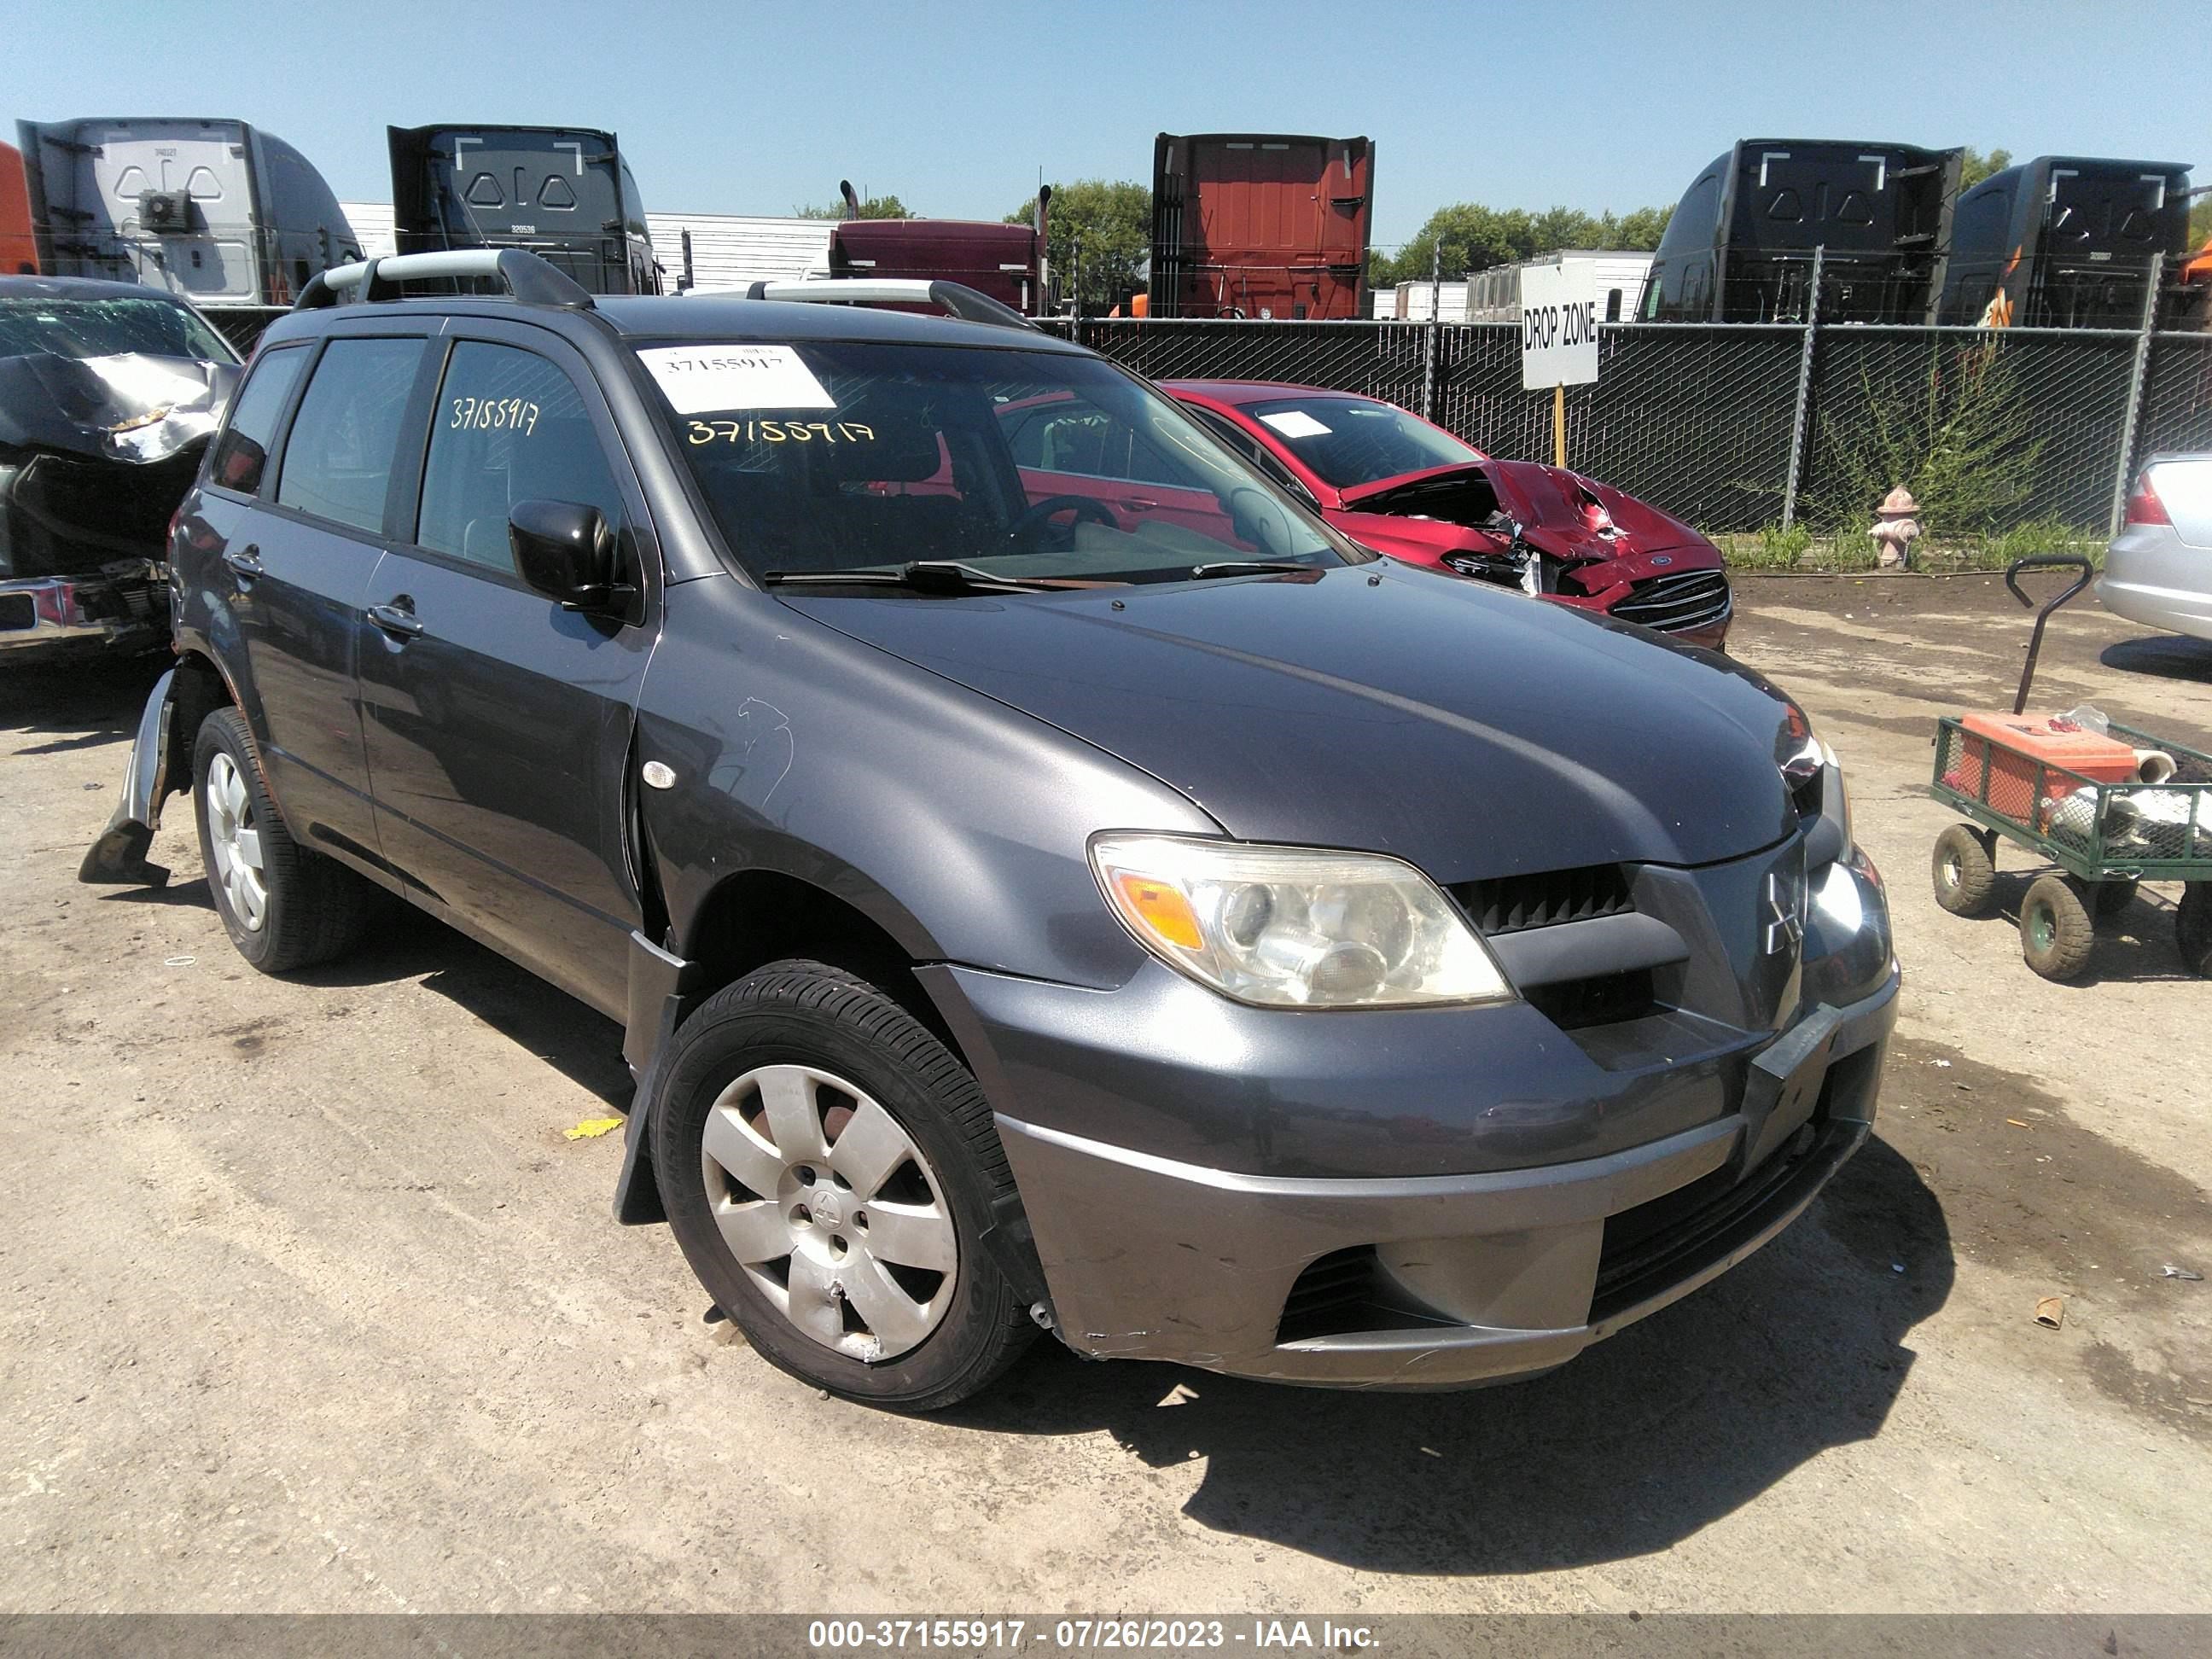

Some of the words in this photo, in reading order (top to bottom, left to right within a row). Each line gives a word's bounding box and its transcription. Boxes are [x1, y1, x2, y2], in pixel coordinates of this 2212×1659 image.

[511, 224, 536, 234] 320536
[1524, 306, 1558, 351] DROP
[1563, 301, 1596, 346] ZONE
[665, 358, 783, 374] 37155917
[451, 397, 539, 437] 37155917
[686, 420, 875, 445] 37155917
